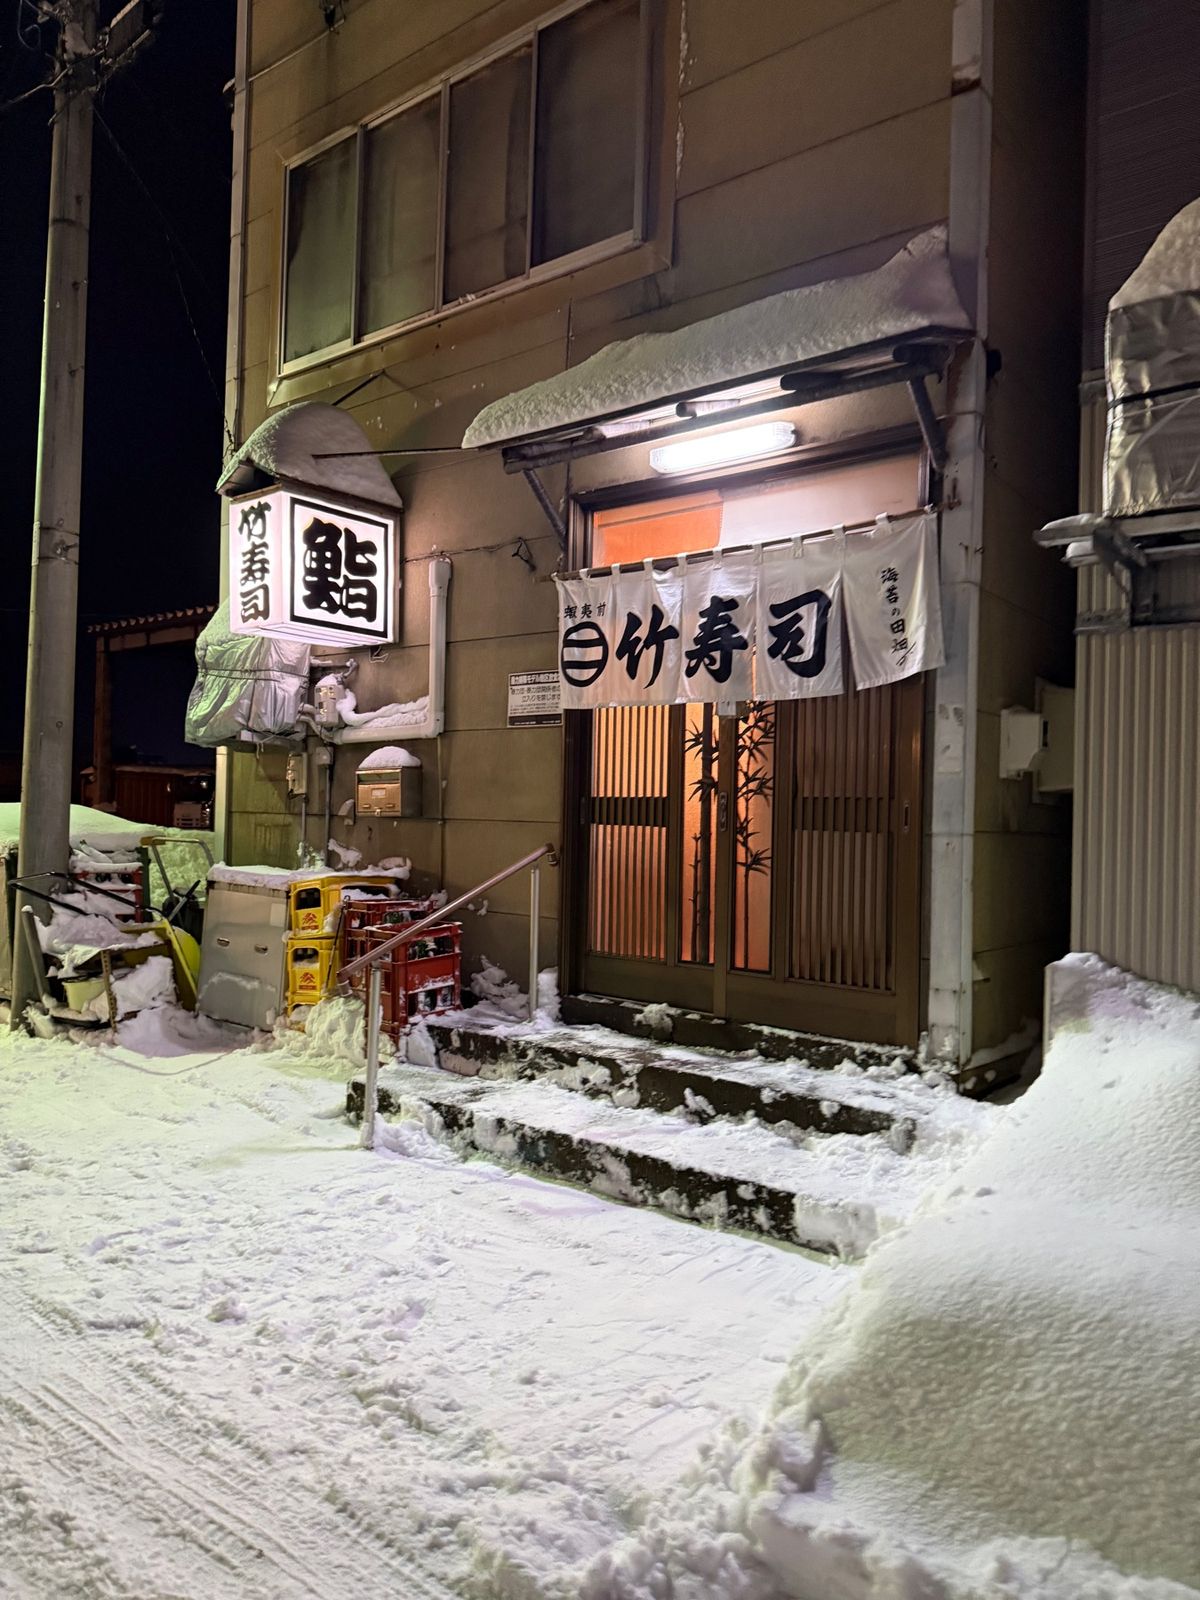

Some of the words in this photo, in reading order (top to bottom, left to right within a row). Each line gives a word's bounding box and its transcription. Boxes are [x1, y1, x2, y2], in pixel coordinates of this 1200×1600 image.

[238, 501, 271, 623] 竹寿司
[302, 517, 378, 622] 鮨
[615, 589, 832, 689] 竹寿司
